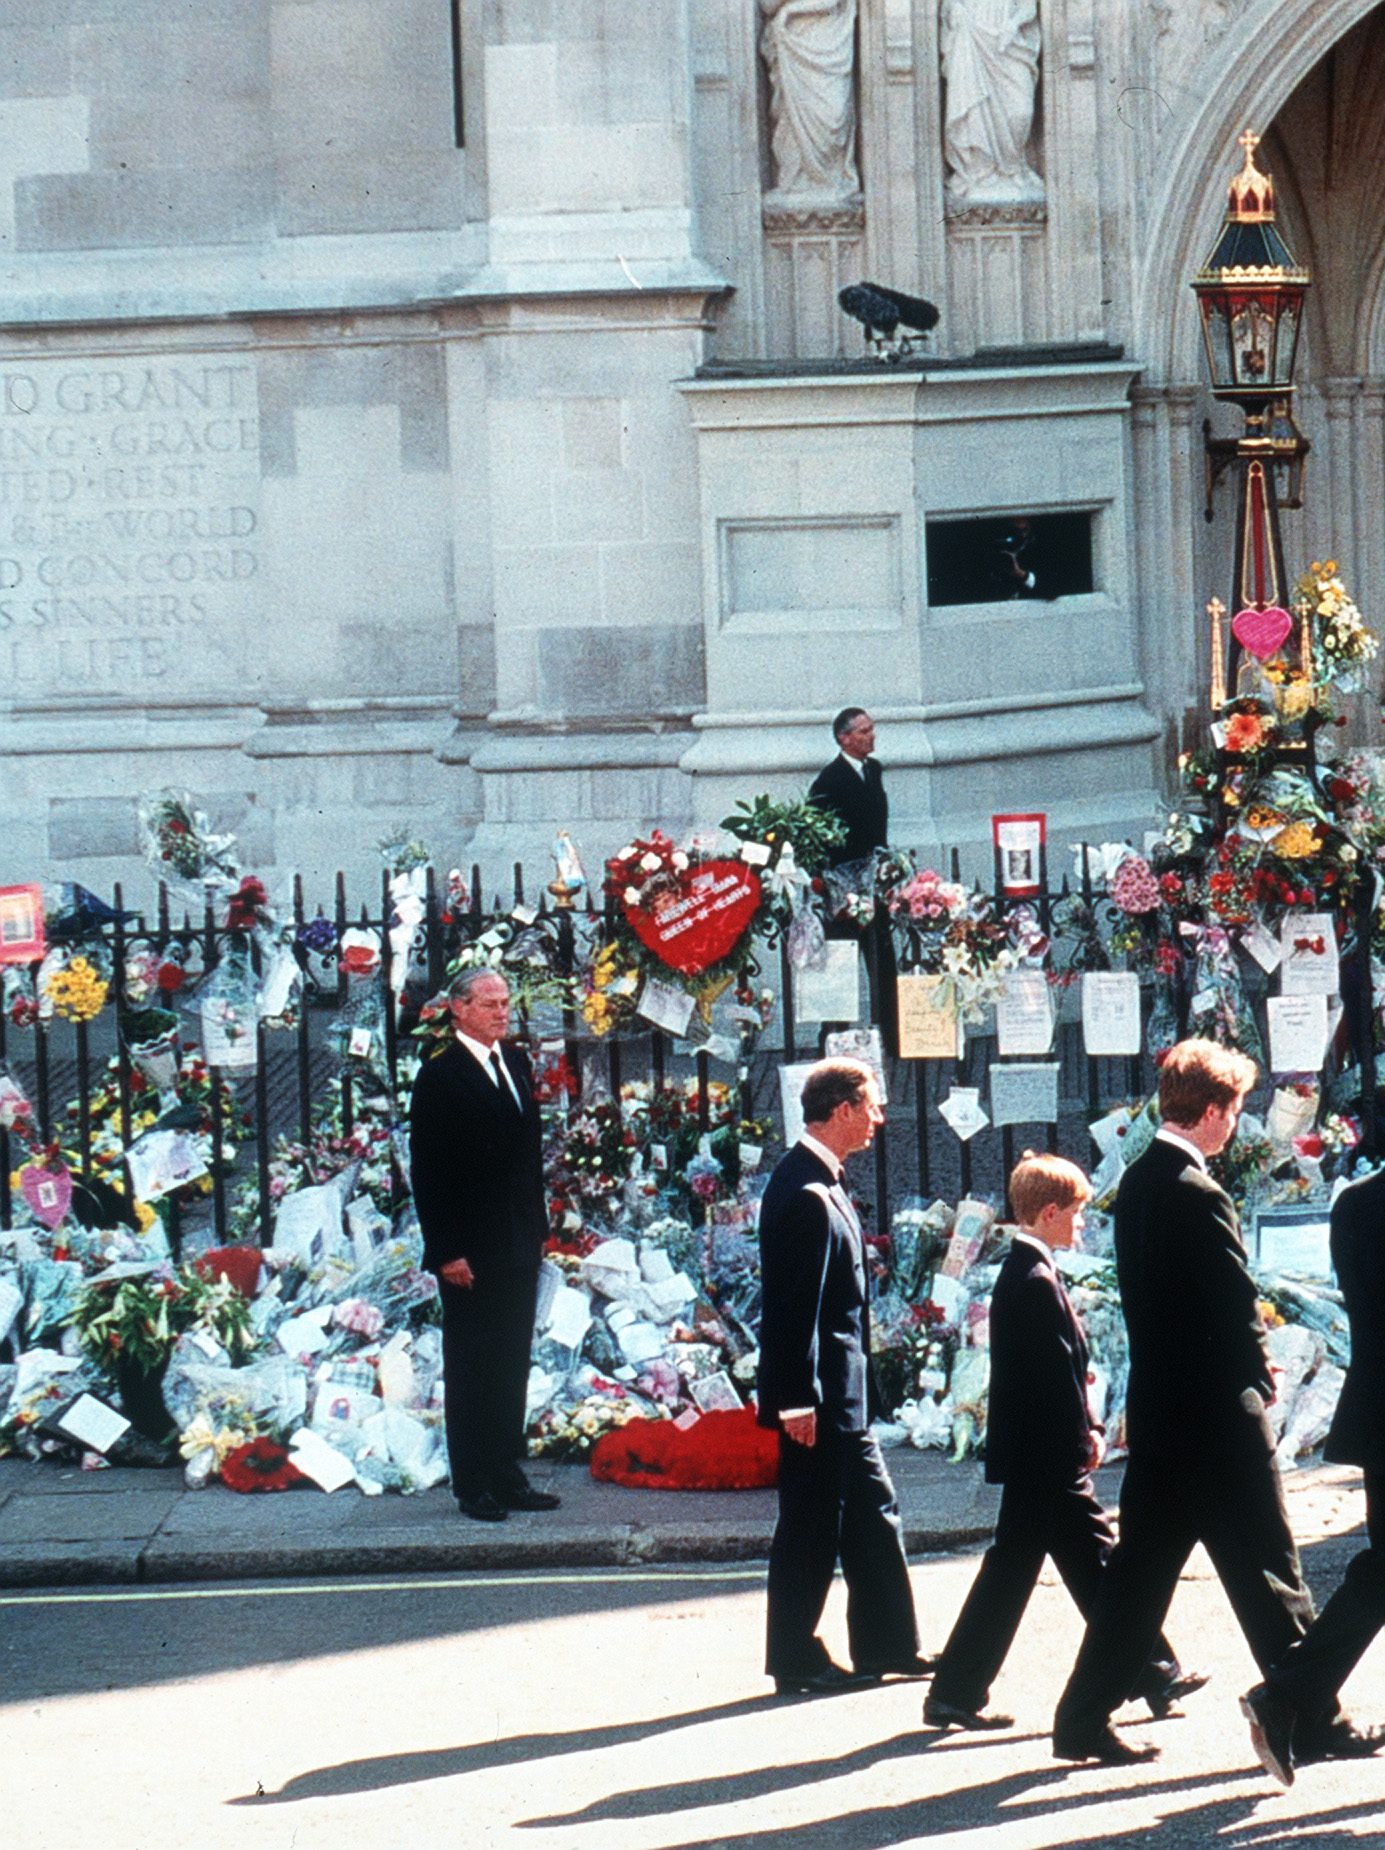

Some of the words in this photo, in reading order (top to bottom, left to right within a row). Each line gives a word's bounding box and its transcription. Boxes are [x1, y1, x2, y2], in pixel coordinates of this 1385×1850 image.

[55, 366, 250, 414] GRANT
[0, 426, 75, 460] NG
[109, 419, 259, 456] GRACE
[104, 464, 206, 499] REST
[12, 512, 36, 544] &
[104, 506, 257, 540] WORLD
[37, 550, 259, 587] CONCORD
[30, 594, 206, 630] SINNERS
[58, 637, 167, 679] LIFE
